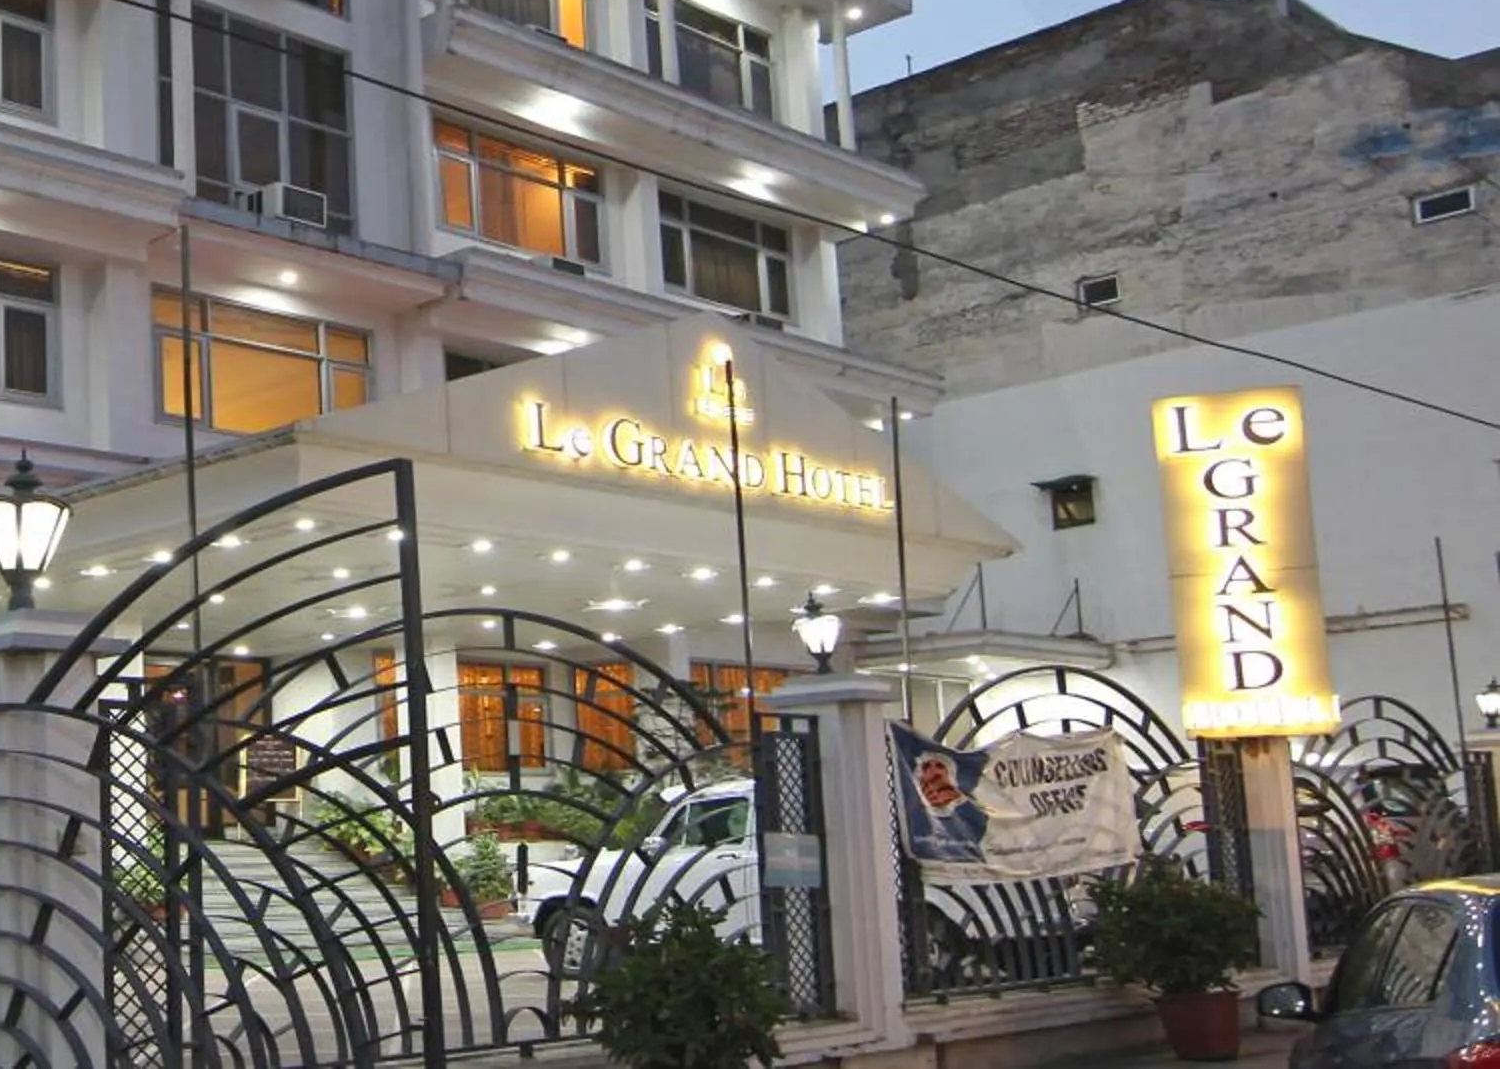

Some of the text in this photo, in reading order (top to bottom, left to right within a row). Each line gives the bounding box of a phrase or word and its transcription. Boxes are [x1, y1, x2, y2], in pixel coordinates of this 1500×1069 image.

[521, 398, 896, 511] Le GRAND HOTEL
[1171, 405, 1286, 454] Le
[1202, 459, 1284, 692] GRAND
